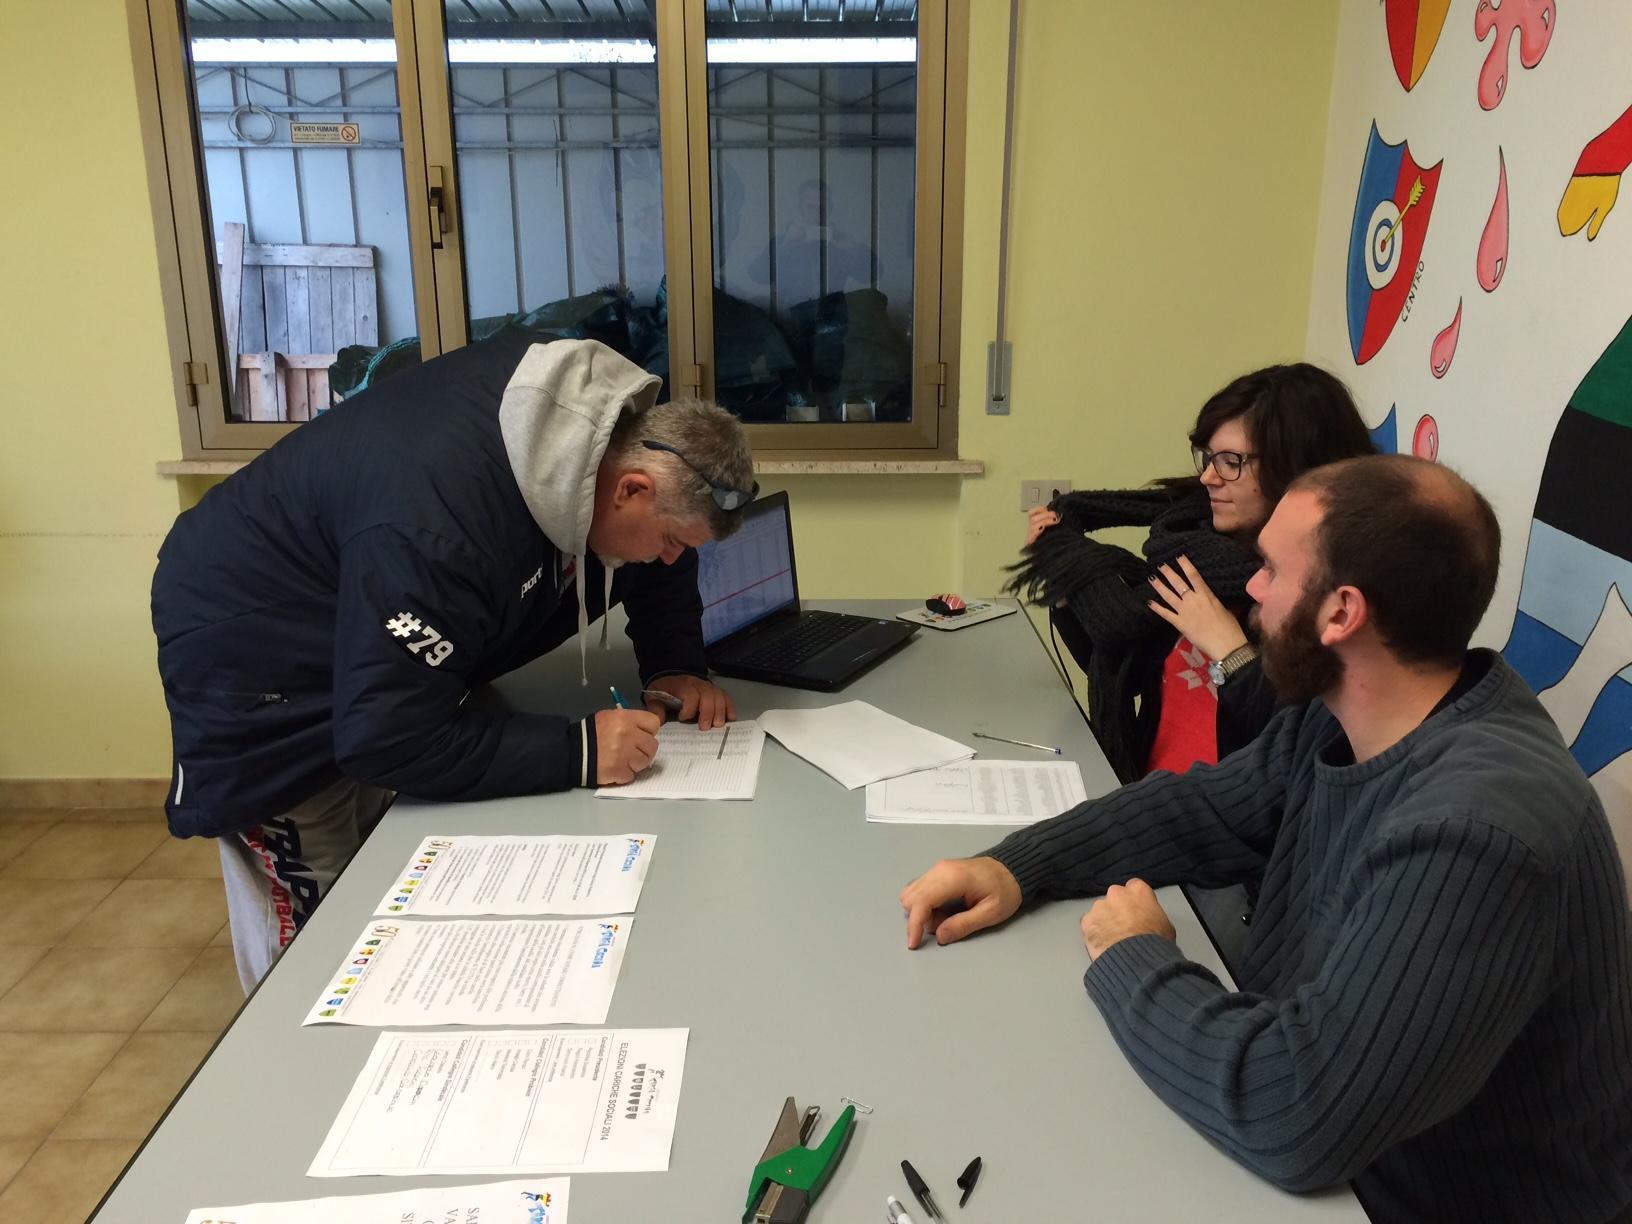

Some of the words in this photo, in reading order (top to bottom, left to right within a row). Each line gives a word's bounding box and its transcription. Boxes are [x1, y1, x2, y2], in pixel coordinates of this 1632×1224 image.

[293, 125, 316, 133] VIETATO
[316, 125, 340, 133] FUMARE
[1401, 260, 1425, 322] CENTRO
[385, 611, 454, 667] #79
[615, 1042, 629, 1071] ELEZIONI
[609, 1070, 623, 1099] CARICHE
[603, 1098, 617, 1126] SOCIALI
[600, 1126, 611, 1141] 2014
